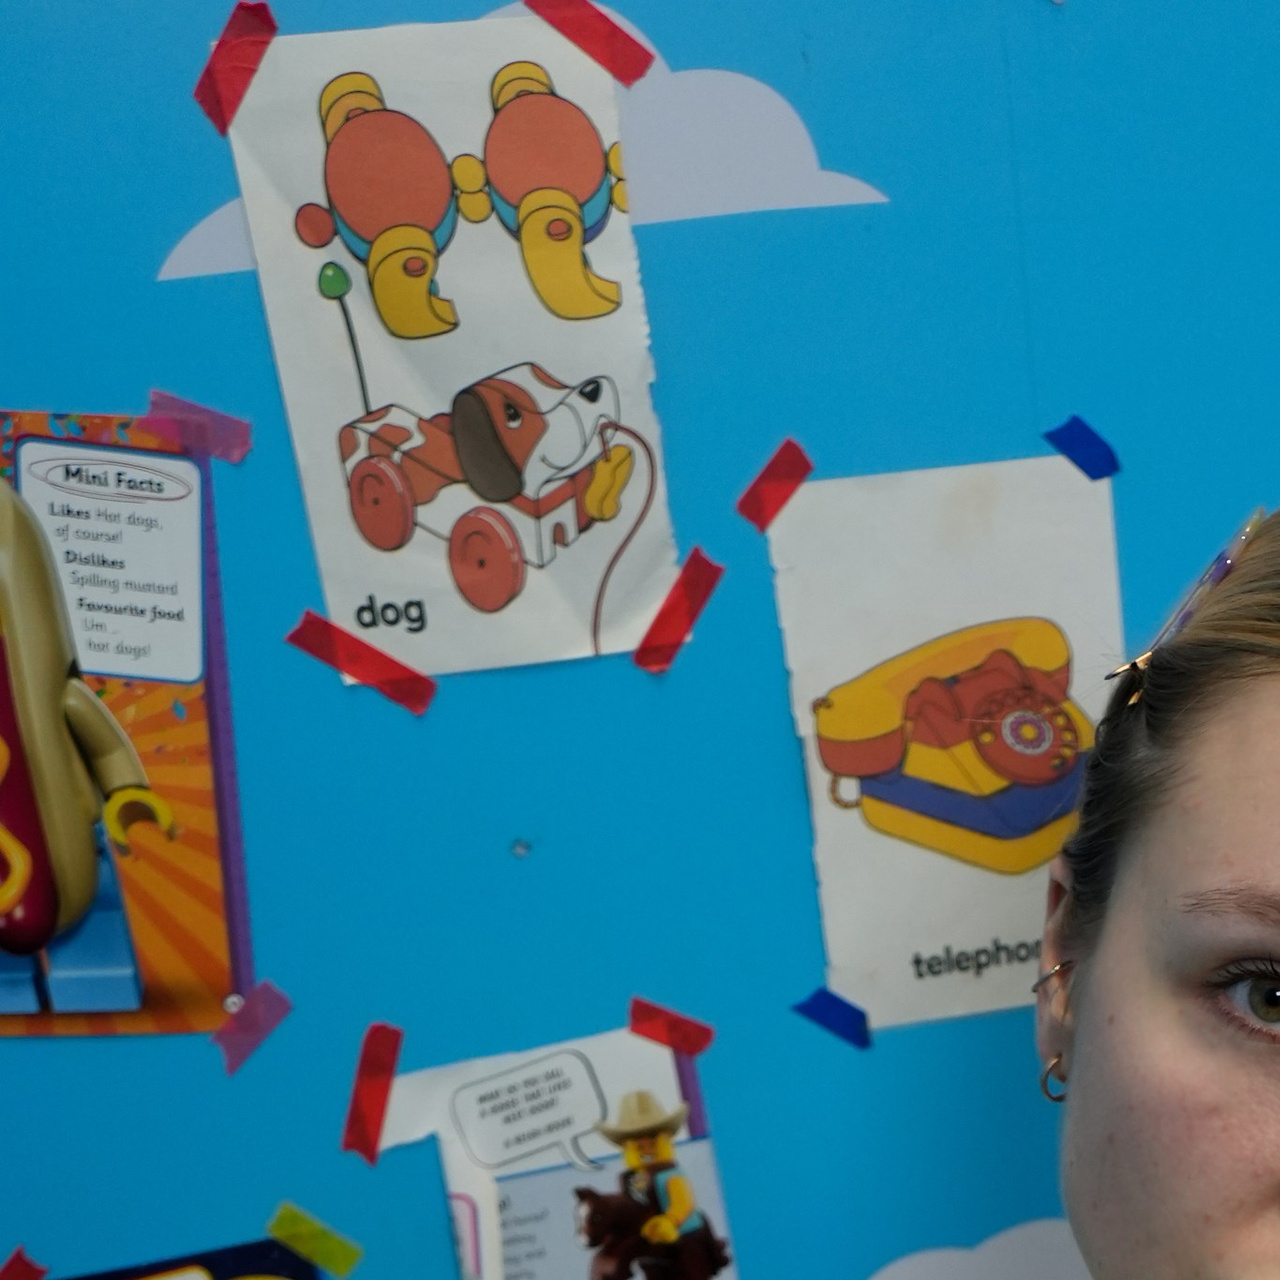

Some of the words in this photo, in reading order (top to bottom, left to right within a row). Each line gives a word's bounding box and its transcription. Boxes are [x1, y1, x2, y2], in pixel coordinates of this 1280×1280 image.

[64, 464, 109, 487] Mini
[115, 471, 165, 494] Facts
[48, 502, 91, 520] Likes
[64, 550, 126, 570] Dislikes
[76, 596, 147, 617] Favourite
[148, 604, 185, 623] food
[355, 594, 427, 633] dog
[912, 937, 1042, 978] telepho
